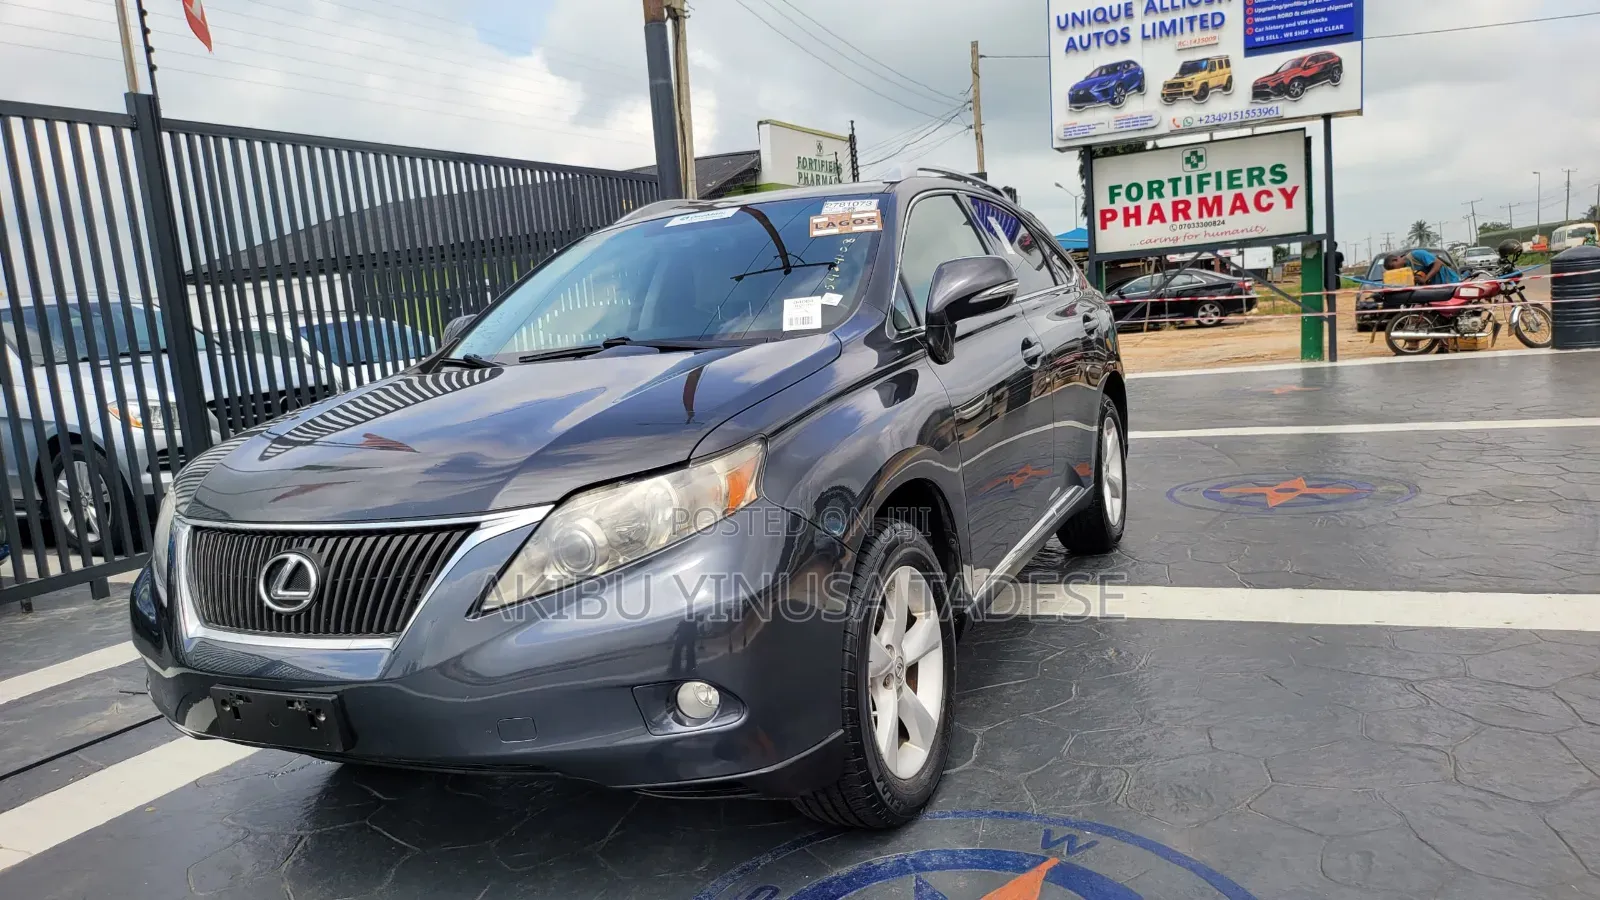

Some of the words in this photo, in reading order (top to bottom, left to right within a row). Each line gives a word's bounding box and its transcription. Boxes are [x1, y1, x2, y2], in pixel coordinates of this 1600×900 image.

[1056, 2, 1134, 31] UNIQUE
[1300, 6, 1326, 16] container
[1327, 3, 1353, 12] shipment
[1309, 17, 1328, 25] checks
[1324, 24, 1344, 32] CLEAR
[1065, 27, 1131, 53] AUTOS
[1141, 11, 1226, 41] LIMITED
[1198, 106, 1280, 124] +2349151553961
[796, 171, 843, 186] PHARMAC
[1108, 163, 1288, 205] FORTIFIERS
[1099, 186, 1300, 231] PHARMACY
[815, 217, 876, 230] LAGOS
[1178, 219, 1226, 230] 07033300824
[1182, 231, 1200, 242] for
[1203, 224, 1269, 239] humanity.
